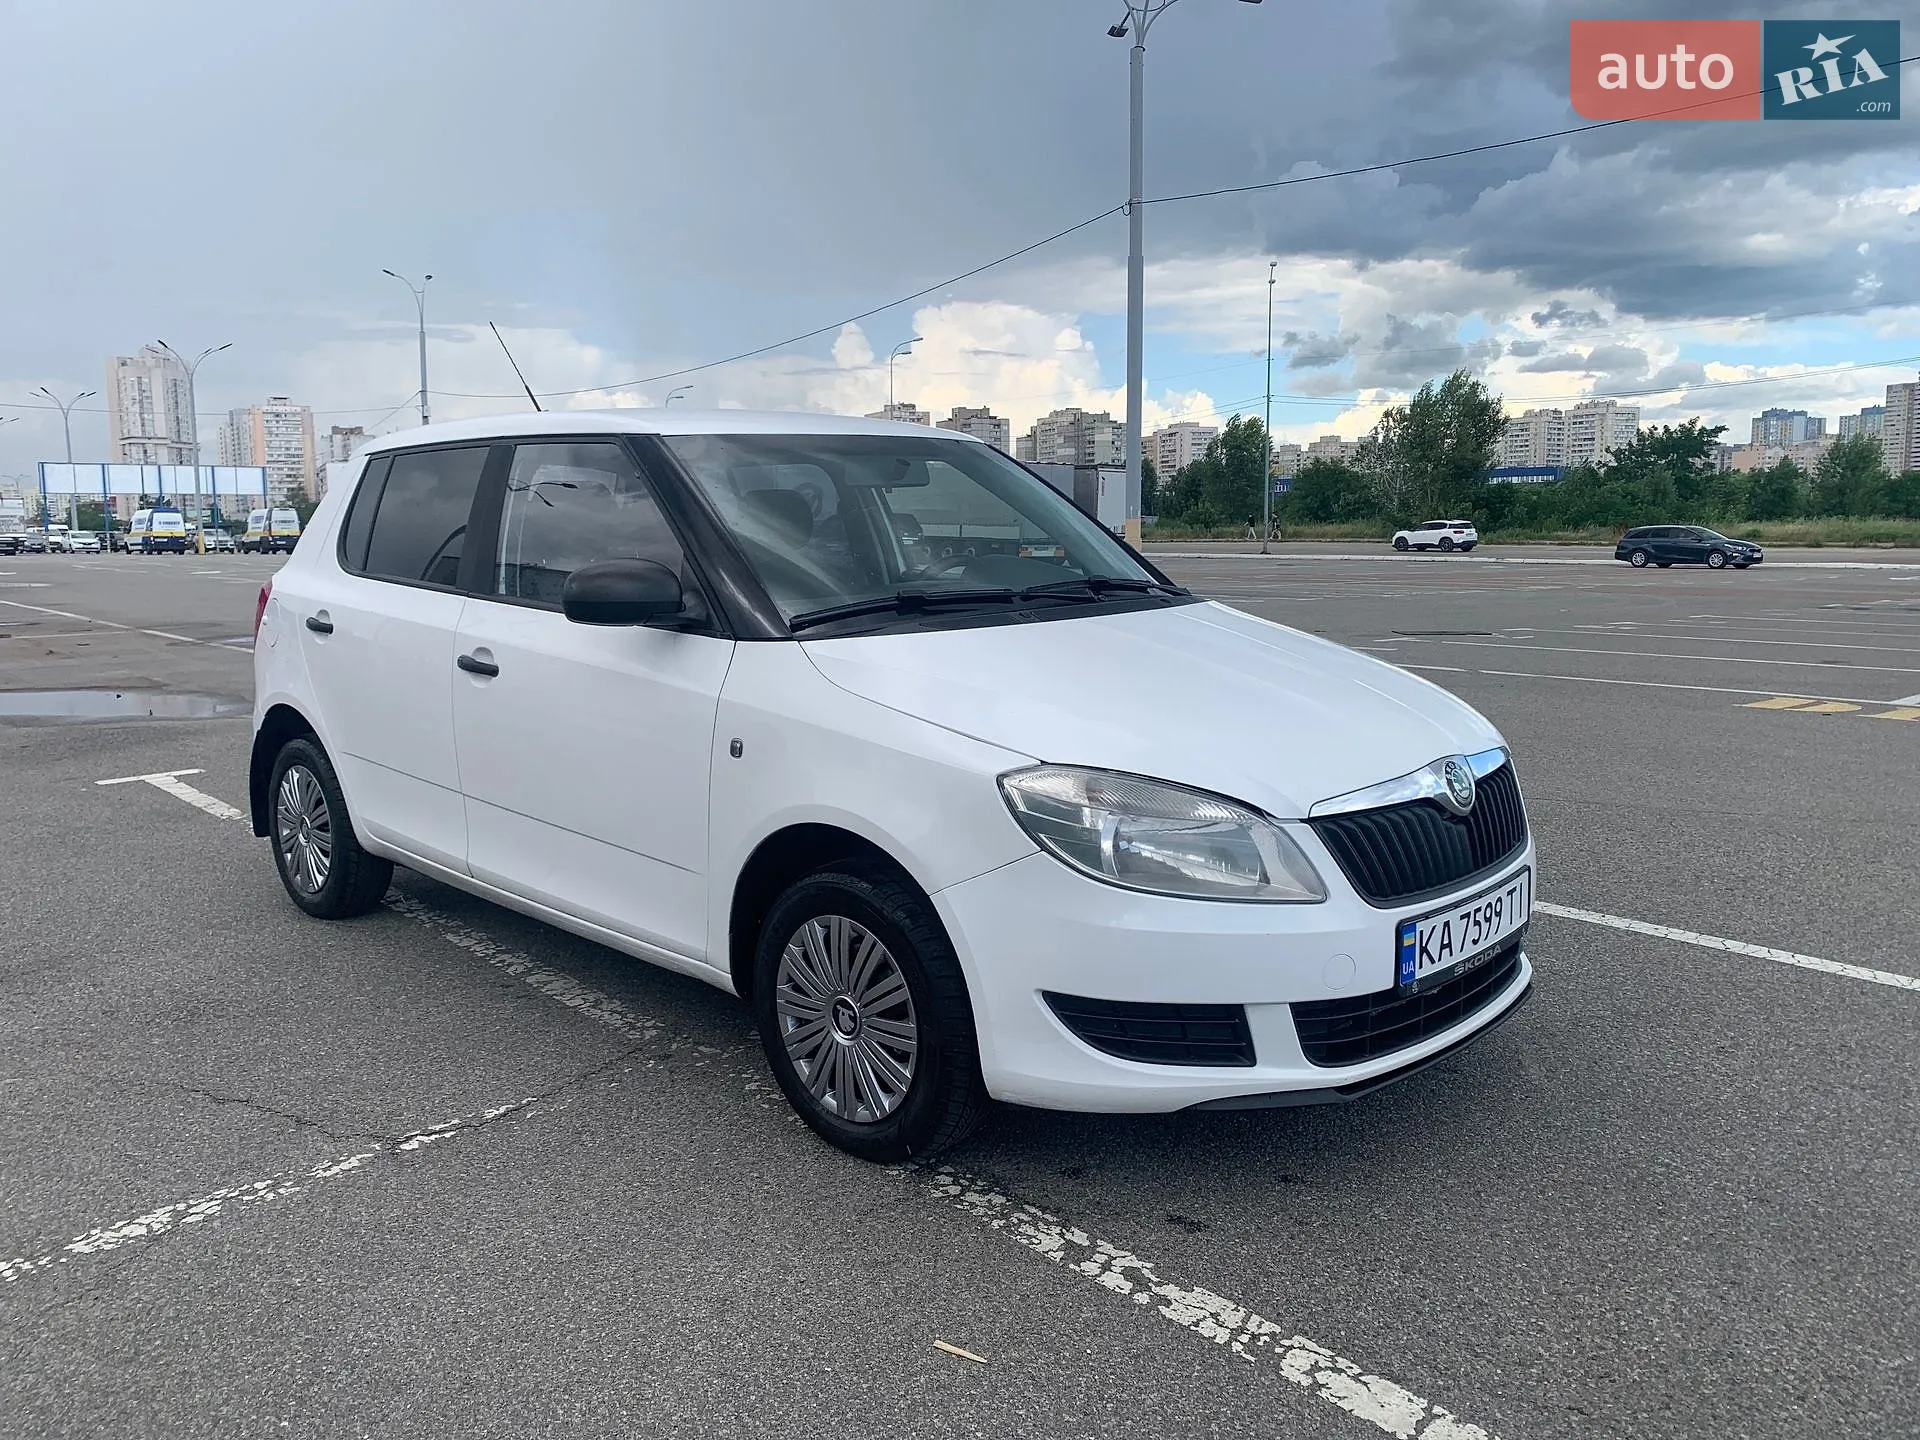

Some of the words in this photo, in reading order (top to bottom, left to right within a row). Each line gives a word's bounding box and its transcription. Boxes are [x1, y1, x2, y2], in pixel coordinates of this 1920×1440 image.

[1418, 919, 1454, 970] KA
[1459, 896, 1503, 953] 7599
[1506, 881, 1523, 925] TI
[1402, 961, 1415, 975] UA
